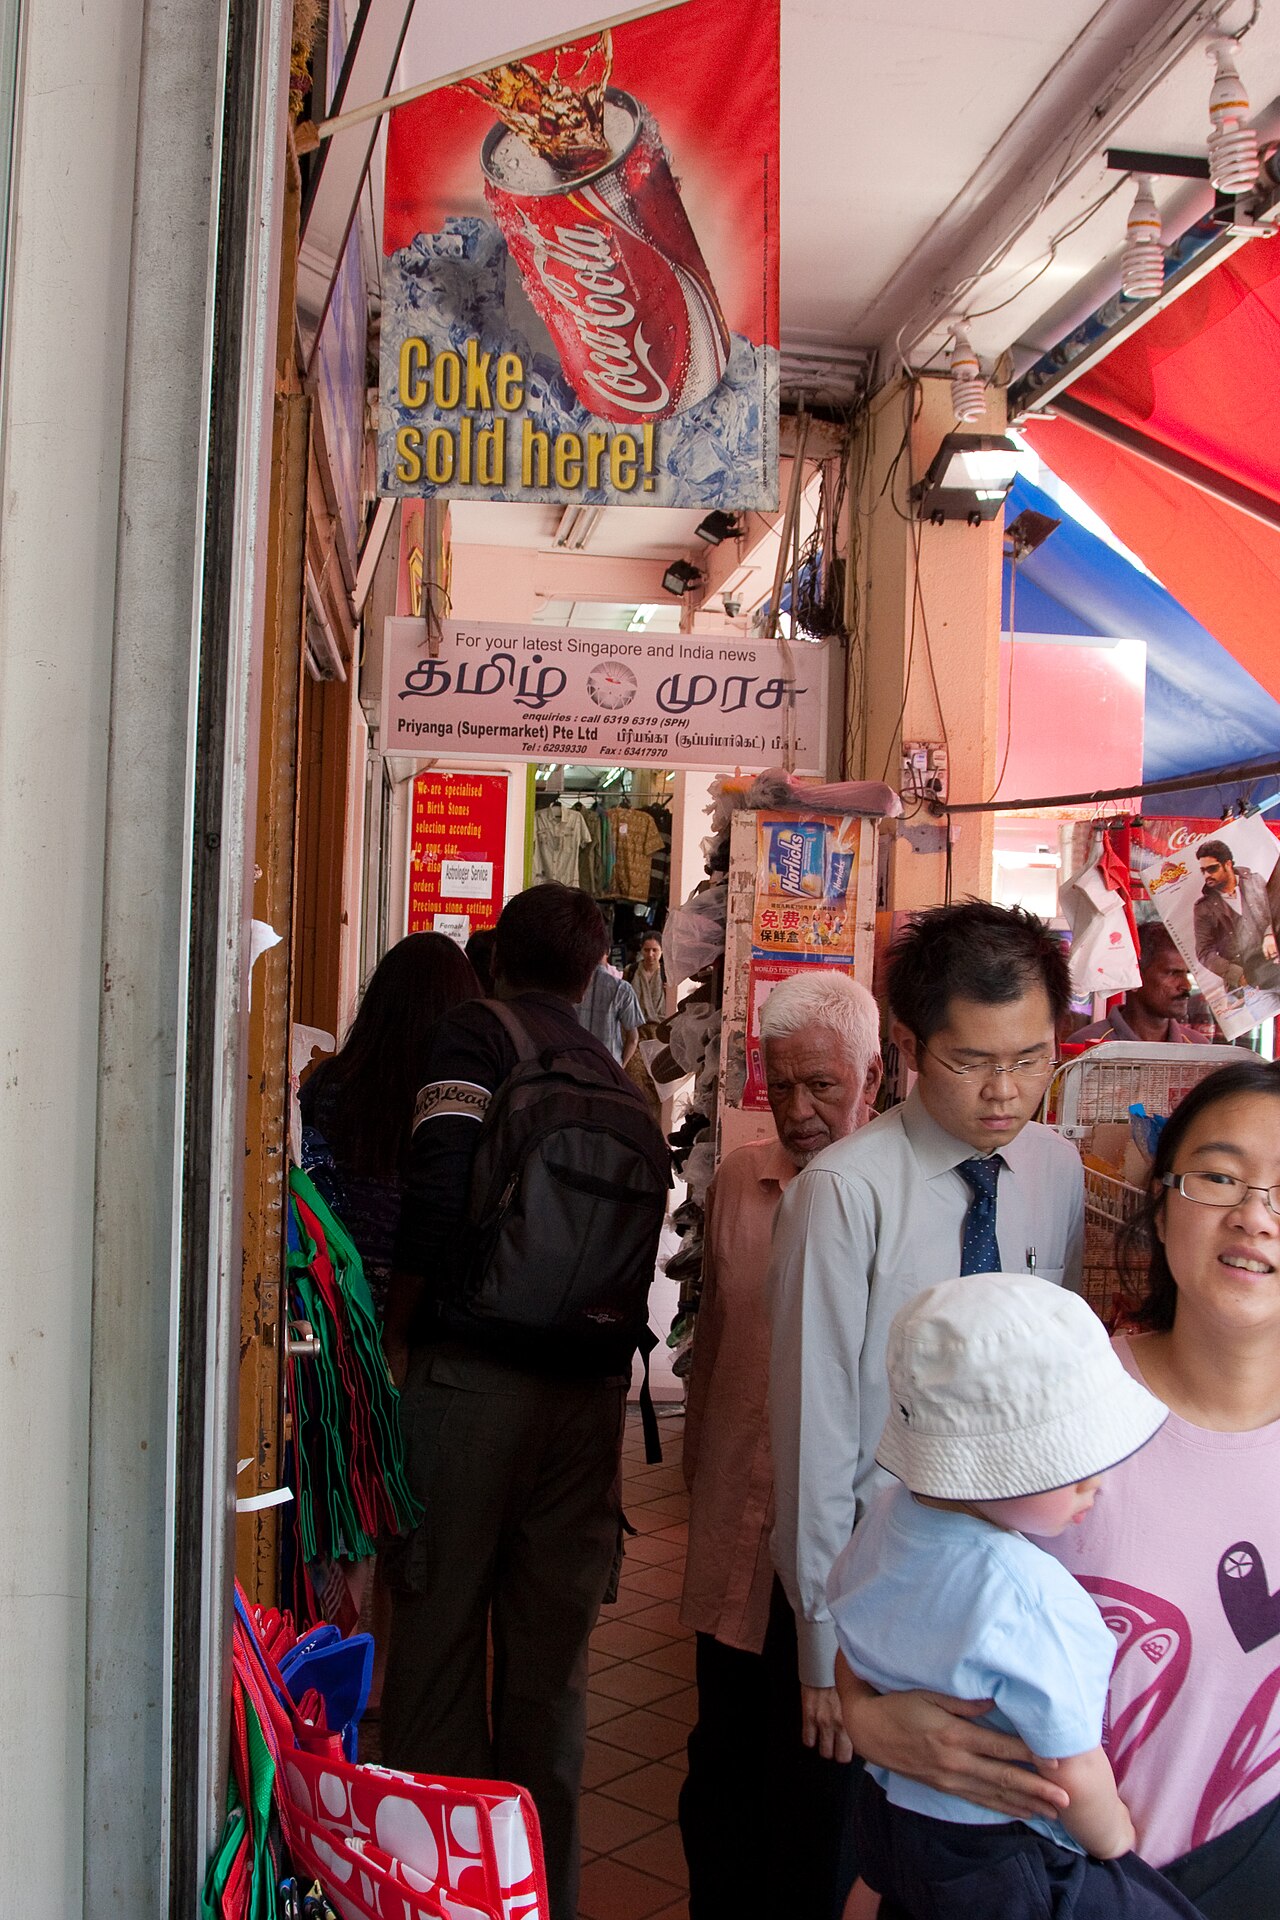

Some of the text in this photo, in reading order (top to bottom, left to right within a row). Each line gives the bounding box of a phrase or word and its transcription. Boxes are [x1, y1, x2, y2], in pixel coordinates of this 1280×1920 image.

[400, 337, 524, 412] Coke
[396, 418, 656, 492] sold here!
[456, 633, 756, 662] For your latest Singapore and India news
[397, 653, 567, 709] தமிழ்
[397, 718, 598, 741] Priyanga (Supermarket) Pte Ltd
[522, 713, 571, 724] enquiries
[581, 714, 601, 723] call
[603, 715, 630, 724] 6319
[632, 717, 658, 726] 6319
[660, 718, 690, 729] (SPH)
[522, 743, 536, 752] Tel
[543, 744, 588, 753] 62939330
[600, 746, 616, 755] Fax
[624, 747, 668, 757] 63417970
[417, 781, 483, 798] We are specialised
[416, 801, 470, 816] in Birth Stones
[415, 820, 482, 839] selection according
[471, 865, 488, 881] Service
[780, 833, 817, 899] Horlicks
[413, 879, 434, 892] orders
[413, 899, 493, 917] Precious stone settings
[760, 909, 800, 930] 免费
[760, 930, 799, 943] 保鲜盒
